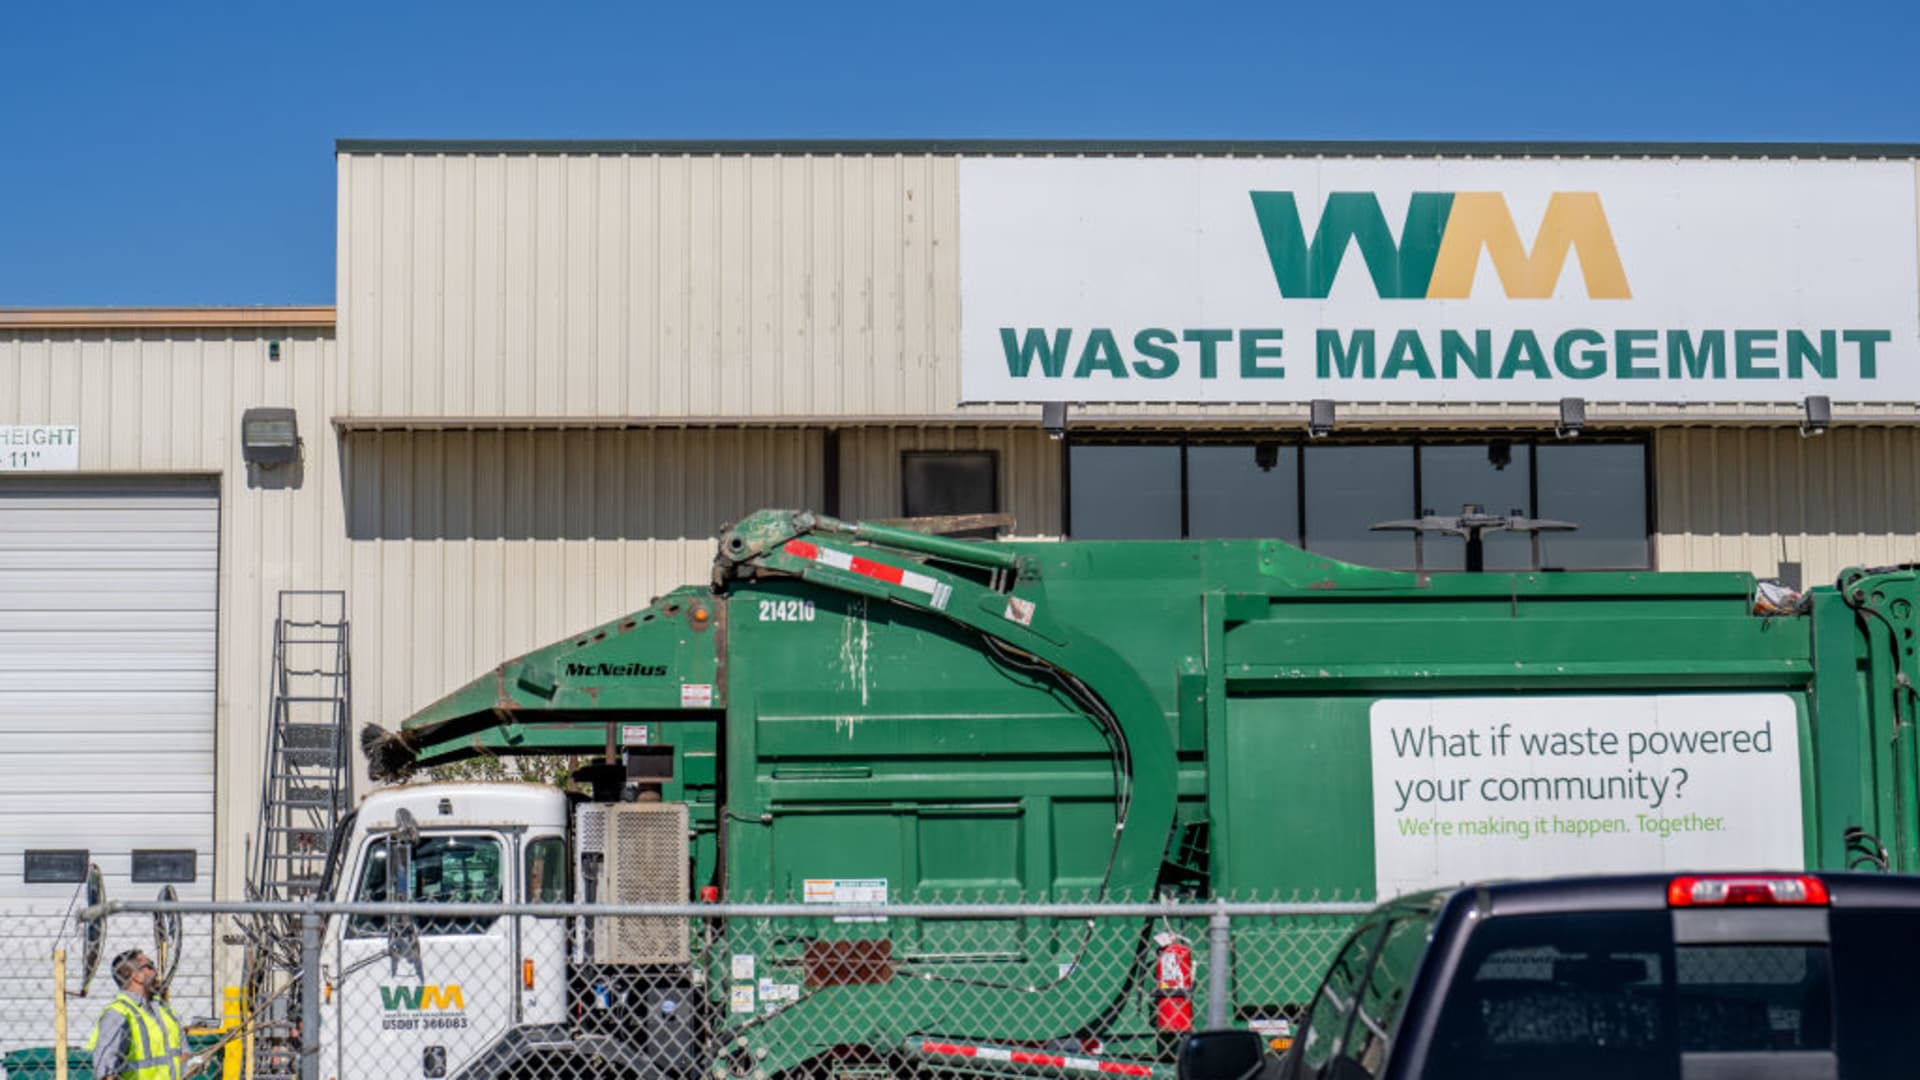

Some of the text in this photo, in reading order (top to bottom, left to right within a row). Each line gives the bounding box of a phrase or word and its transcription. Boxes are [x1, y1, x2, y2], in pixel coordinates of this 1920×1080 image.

[1249, 191, 1632, 300] WM
[1001, 328, 1890, 379] WASTE MANAGEMENT
[759, 600, 815, 621] 214210
[565, 662, 668, 677] McNeilus
[1391, 721, 1772, 763] What if waste powered
[1395, 768, 1689, 812] your community?
[1398, 813, 1726, 840] We're making it happen. Together.
[380, 984, 465, 1010] WM
